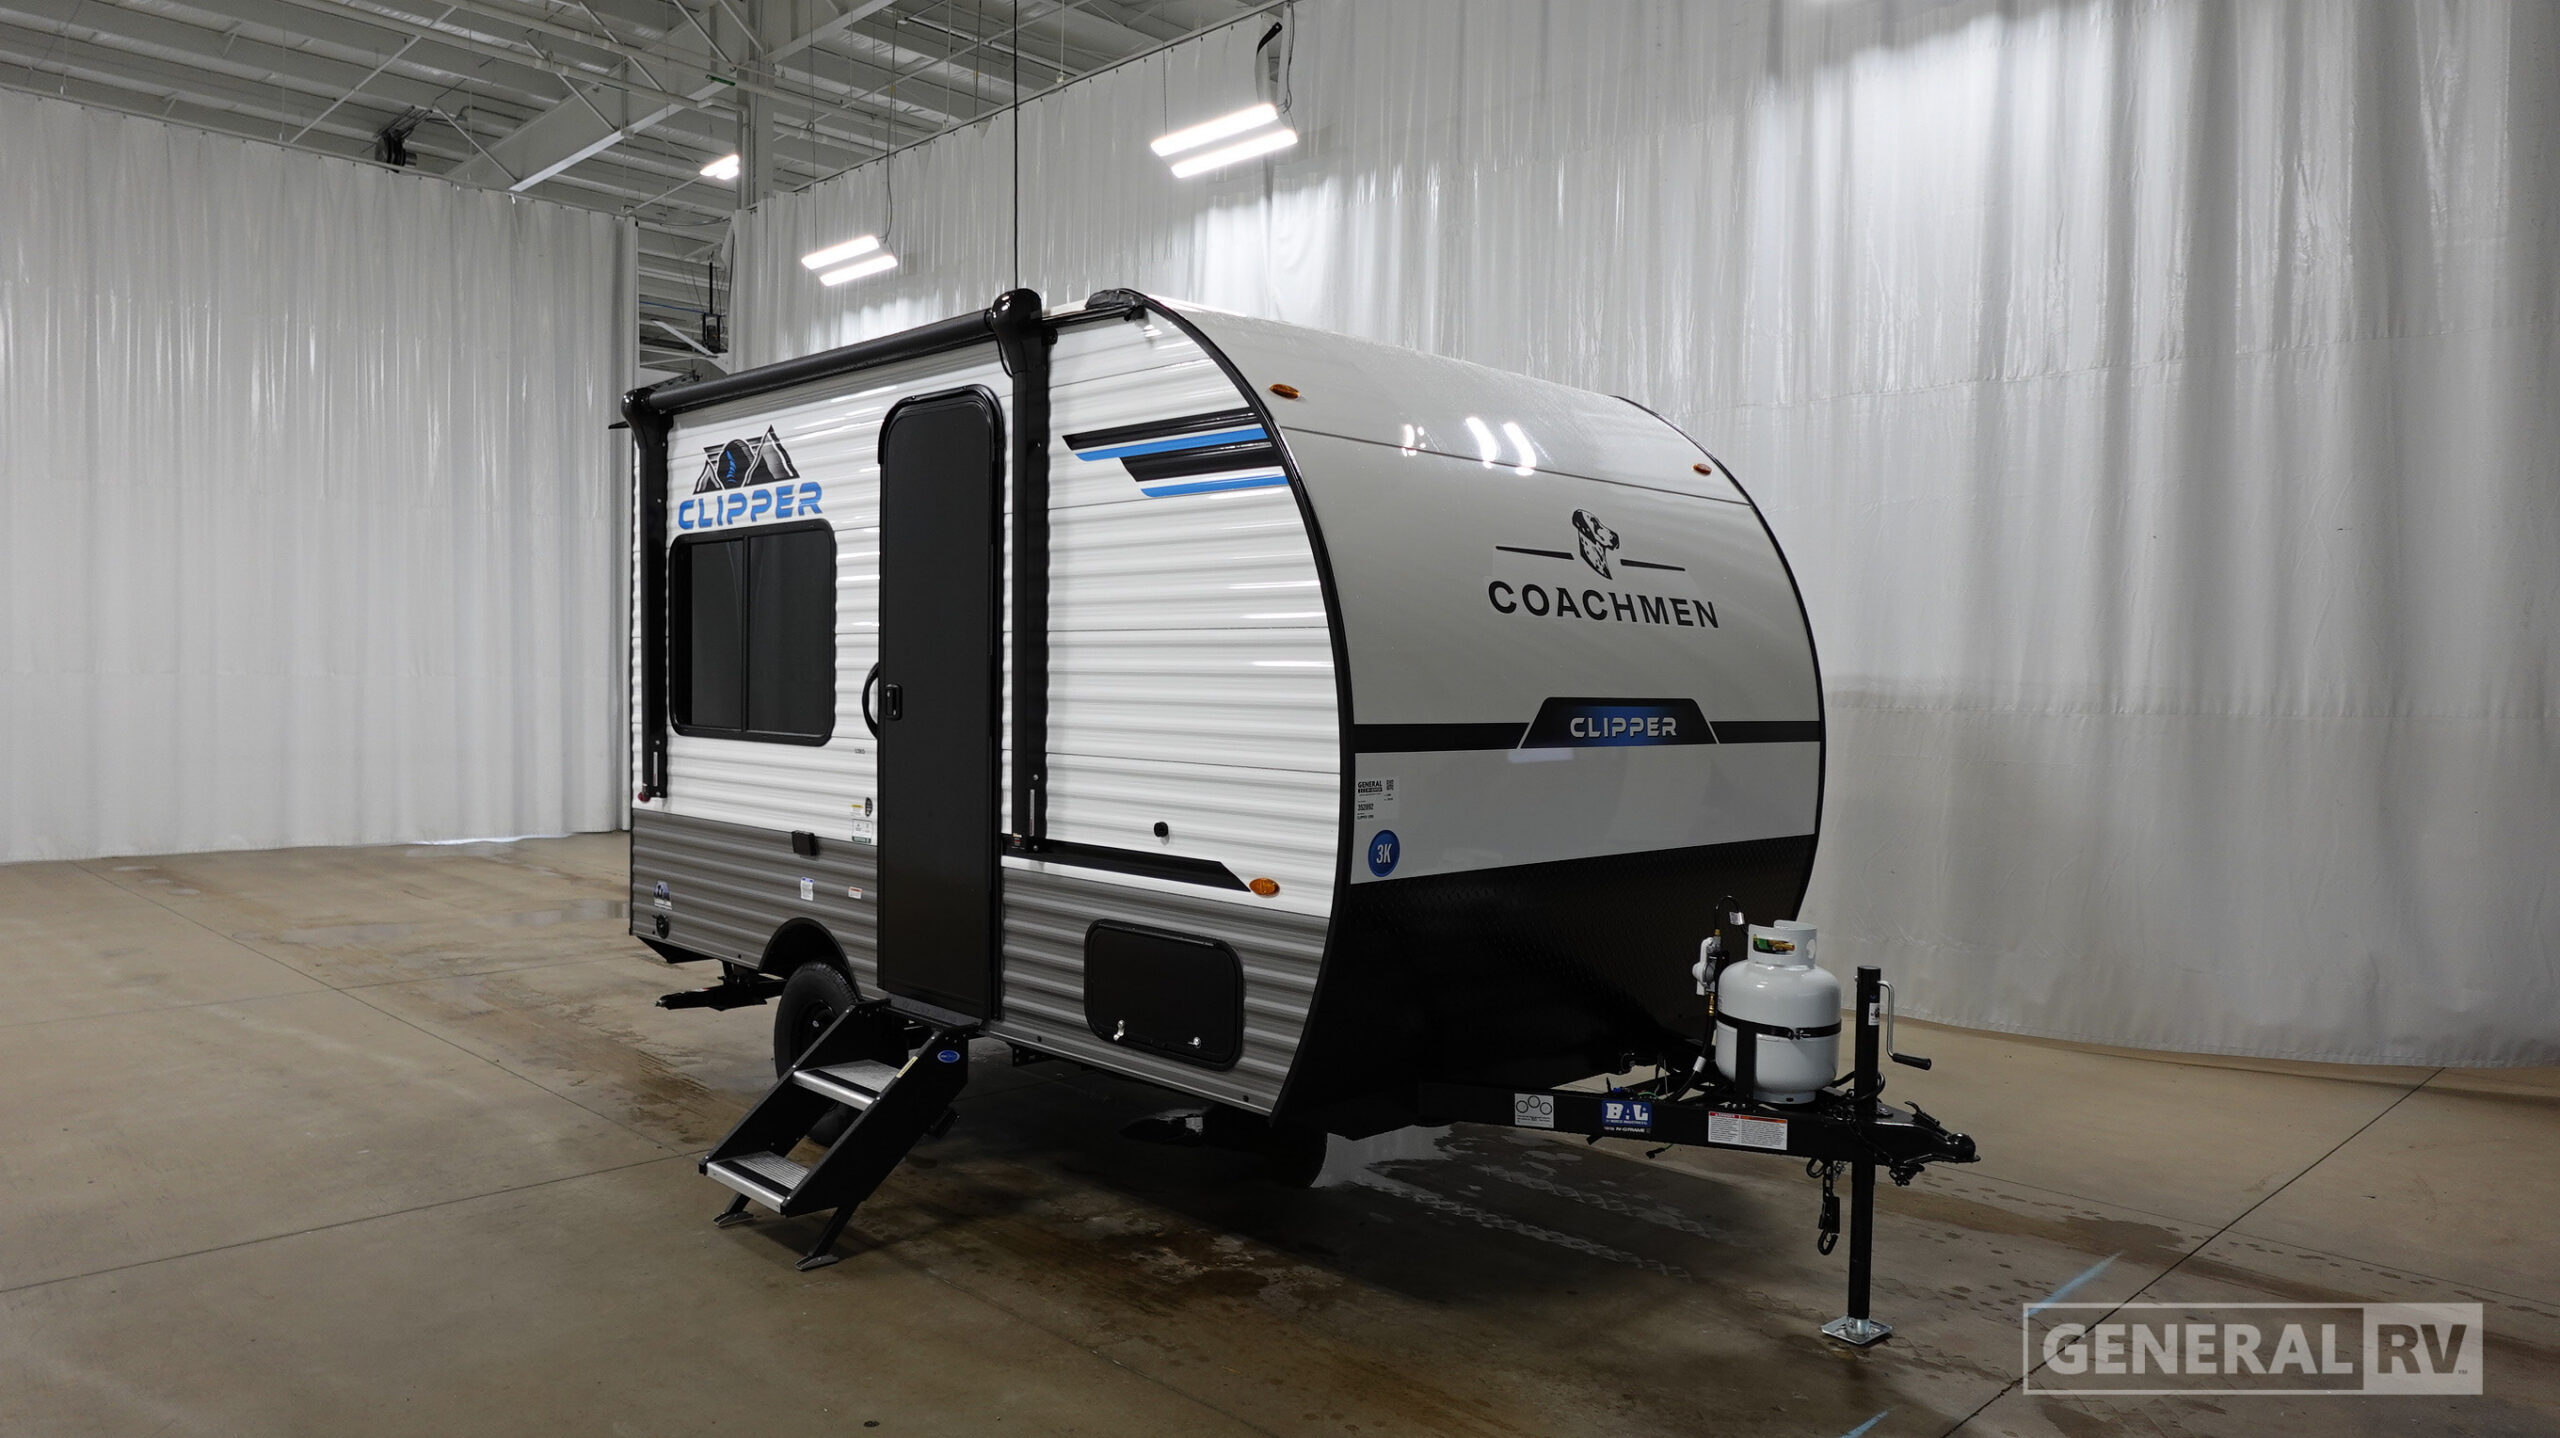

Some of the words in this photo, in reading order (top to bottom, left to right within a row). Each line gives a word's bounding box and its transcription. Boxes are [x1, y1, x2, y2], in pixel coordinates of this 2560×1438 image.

[677, 481, 823, 530] CLIPPER
[1488, 580, 1720, 629] COACHMEN
[1570, 716, 1678, 739] CLIPPER
[1358, 780, 1382, 788] GENERAL
[1376, 844, 1392, 864] 3K
[1606, 1103, 1649, 1121] BAL
